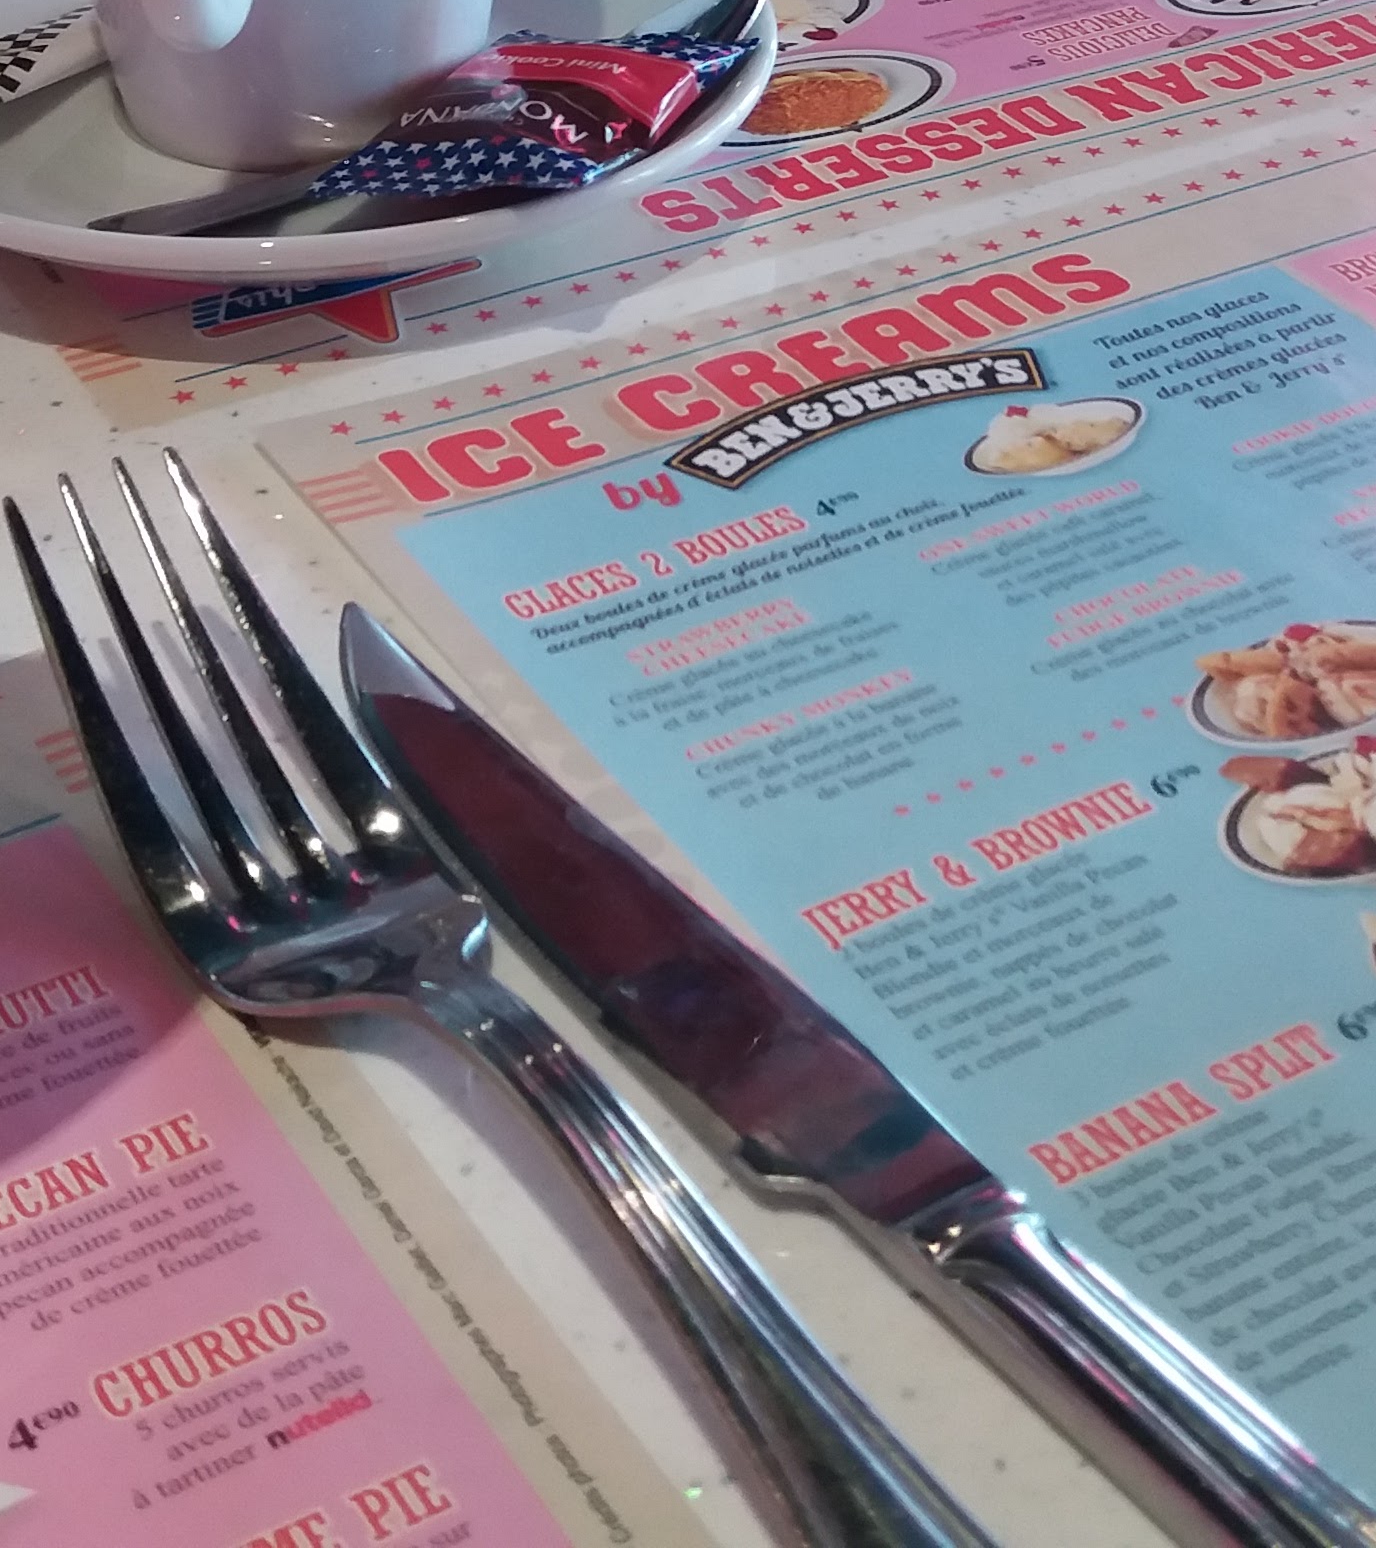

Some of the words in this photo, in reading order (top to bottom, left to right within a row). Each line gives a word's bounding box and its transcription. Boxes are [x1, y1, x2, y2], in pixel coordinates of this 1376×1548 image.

[1022, 6, 1152, 47] PANCAKES
[1048, 22, 1176, 61] DELICIOUS
[593, 58, 629, 77] Mini
[640, 93, 1087, 234] DESSERTS
[1093, 323, 1165, 350] Toutes
[1166, 312, 1203, 330] nos
[1204, 291, 1270, 320] glaces
[1108, 356, 1130, 370] et
[1132, 344, 1170, 362] nos
[1170, 302, 1302, 350] compositions
[1115, 369, 1162, 390] sont
[1164, 335, 1256, 375] réalisées
[1257, 331, 1276, 344] à
[1275, 311, 1336, 341] partir
[377, 407, 606, 503] ICE
[617, 253, 1132, 432] CREAMS
[1156, 381, 1194, 400] des
[1194, 355, 1270, 388] crèmes
[1270, 332, 1348, 364] glacées
[1194, 390, 1242, 410] Ben
[601, 471, 684, 512] by
[504, 561, 640, 620] GLACES
[640, 551, 674, 577] 2
[673, 505, 808, 565] BOULES
[582, 601, 645, 625] boules
[646, 589, 671, 604] de
[791, 522, 867, 558] parfums
[760, 569, 783, 584] de
[883, 526, 906, 543] de
[800, 869, 928, 952] JERRY
[932, 854, 978, 888] &
[970, 781, 1154, 873] BROWNIE
[1027, 1080, 1220, 1188] BANANA
[1207, 1021, 1338, 1103] SPLIT
[119, 1112, 210, 1174] PIE
[167, 1156, 225, 1189] tarte
[79, 1199, 257, 1282] accompagnée
[128, 1206, 176, 1234] aux
[181, 1179, 242, 1212] noix
[30, 1305, 64, 1332] de
[70, 1269, 153, 1317] crème
[91, 1290, 329, 1419] CHURROS
[134, 1417, 156, 1441] 5
[159, 1378, 266, 1432] churros
[271, 1339, 352, 1384] servis
[165, 1424, 232, 1463] avec
[235, 1407, 271, 1431] de
[273, 1389, 305, 1413] la
[306, 1363, 366, 1405] pâte
[7, 1400, 82, 1452] 4€90
[131, 1487, 152, 1511] à
[154, 1443, 259, 1499] tartiner
[348, 1462, 454, 1542] PIE
